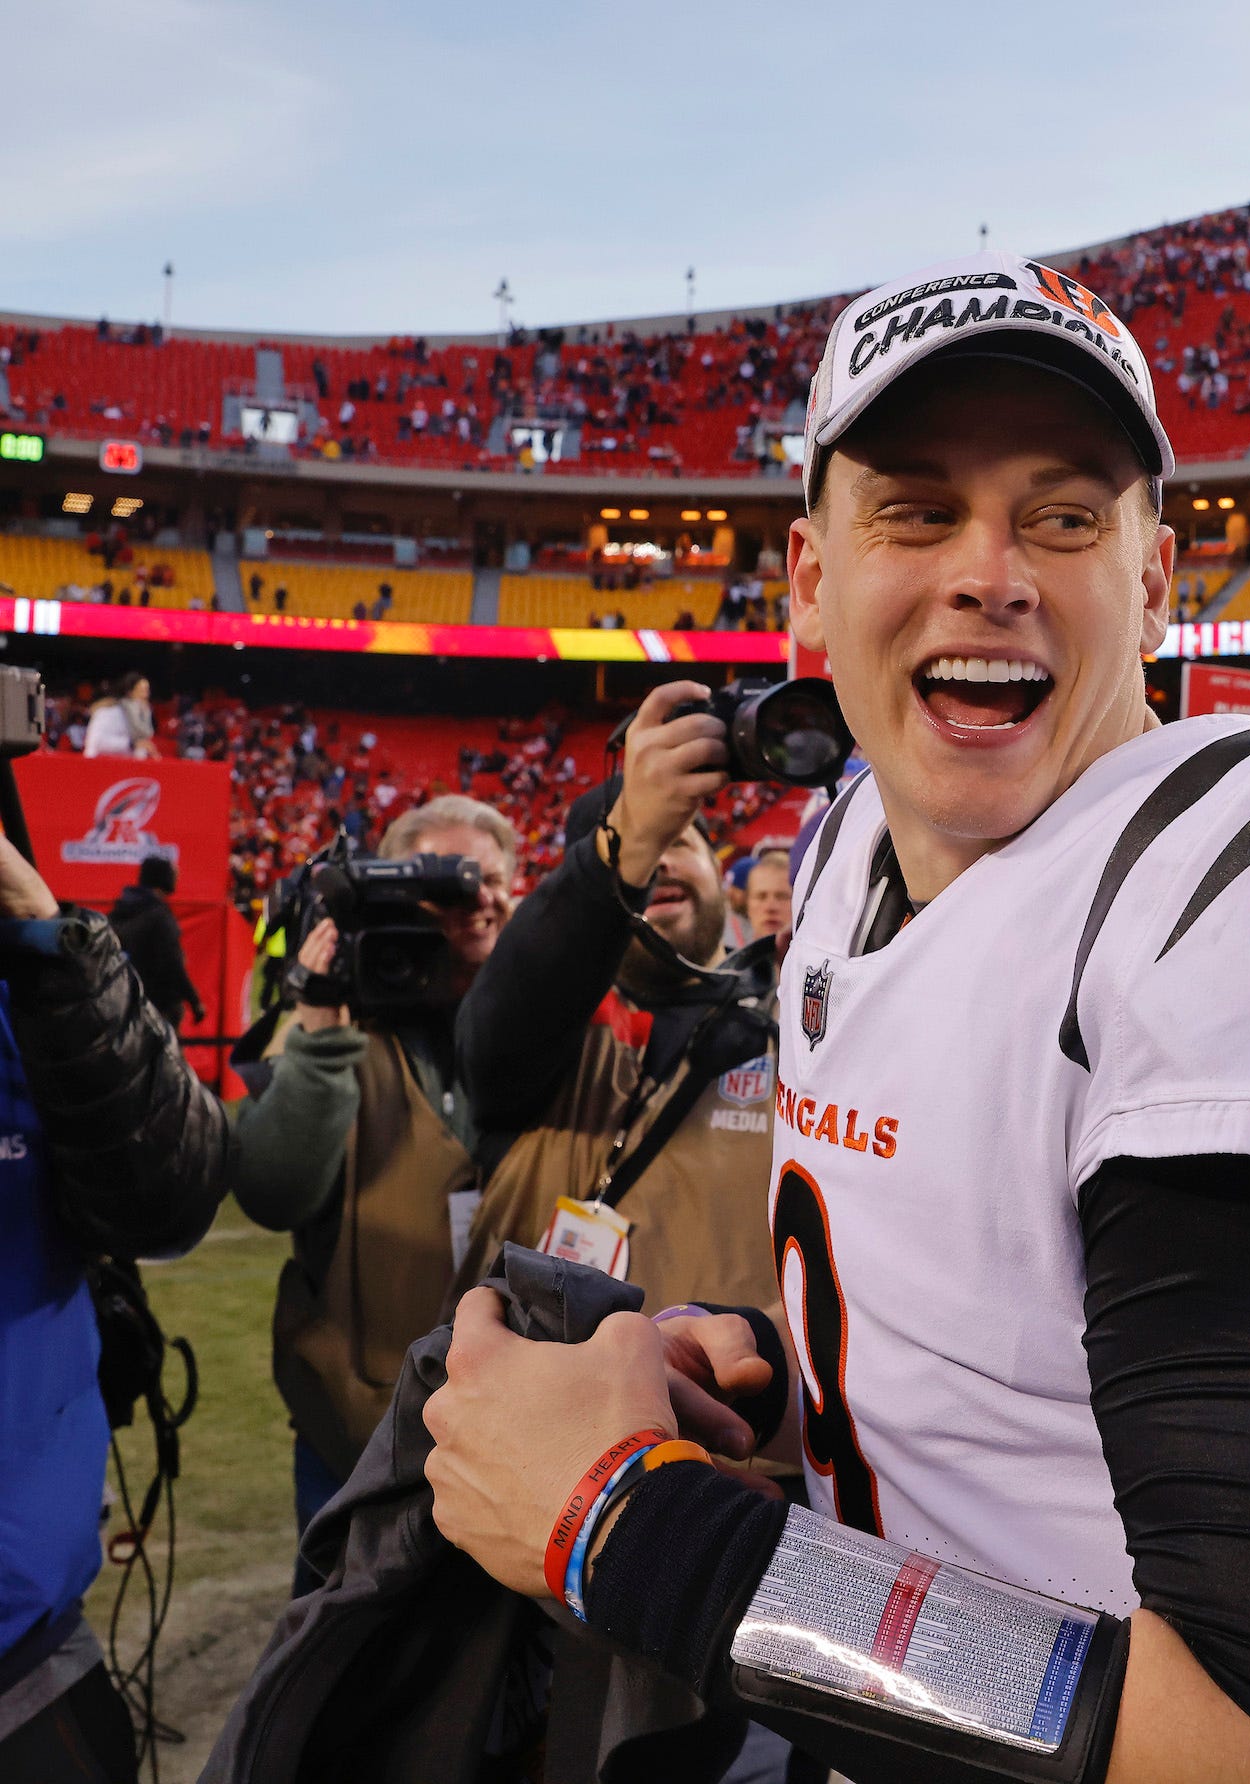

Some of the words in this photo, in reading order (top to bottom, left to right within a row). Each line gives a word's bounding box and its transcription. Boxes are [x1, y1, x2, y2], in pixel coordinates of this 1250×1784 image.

[860, 273, 1000, 323] CONFERENCE
[725, 1070, 763, 1097] NFL
[710, 1108, 769, 1134] MEDIA
[775, 1076, 900, 1159] ENGALS
[553, 1495, 585, 1550] MIND
[588, 1436, 641, 1482] HEART
